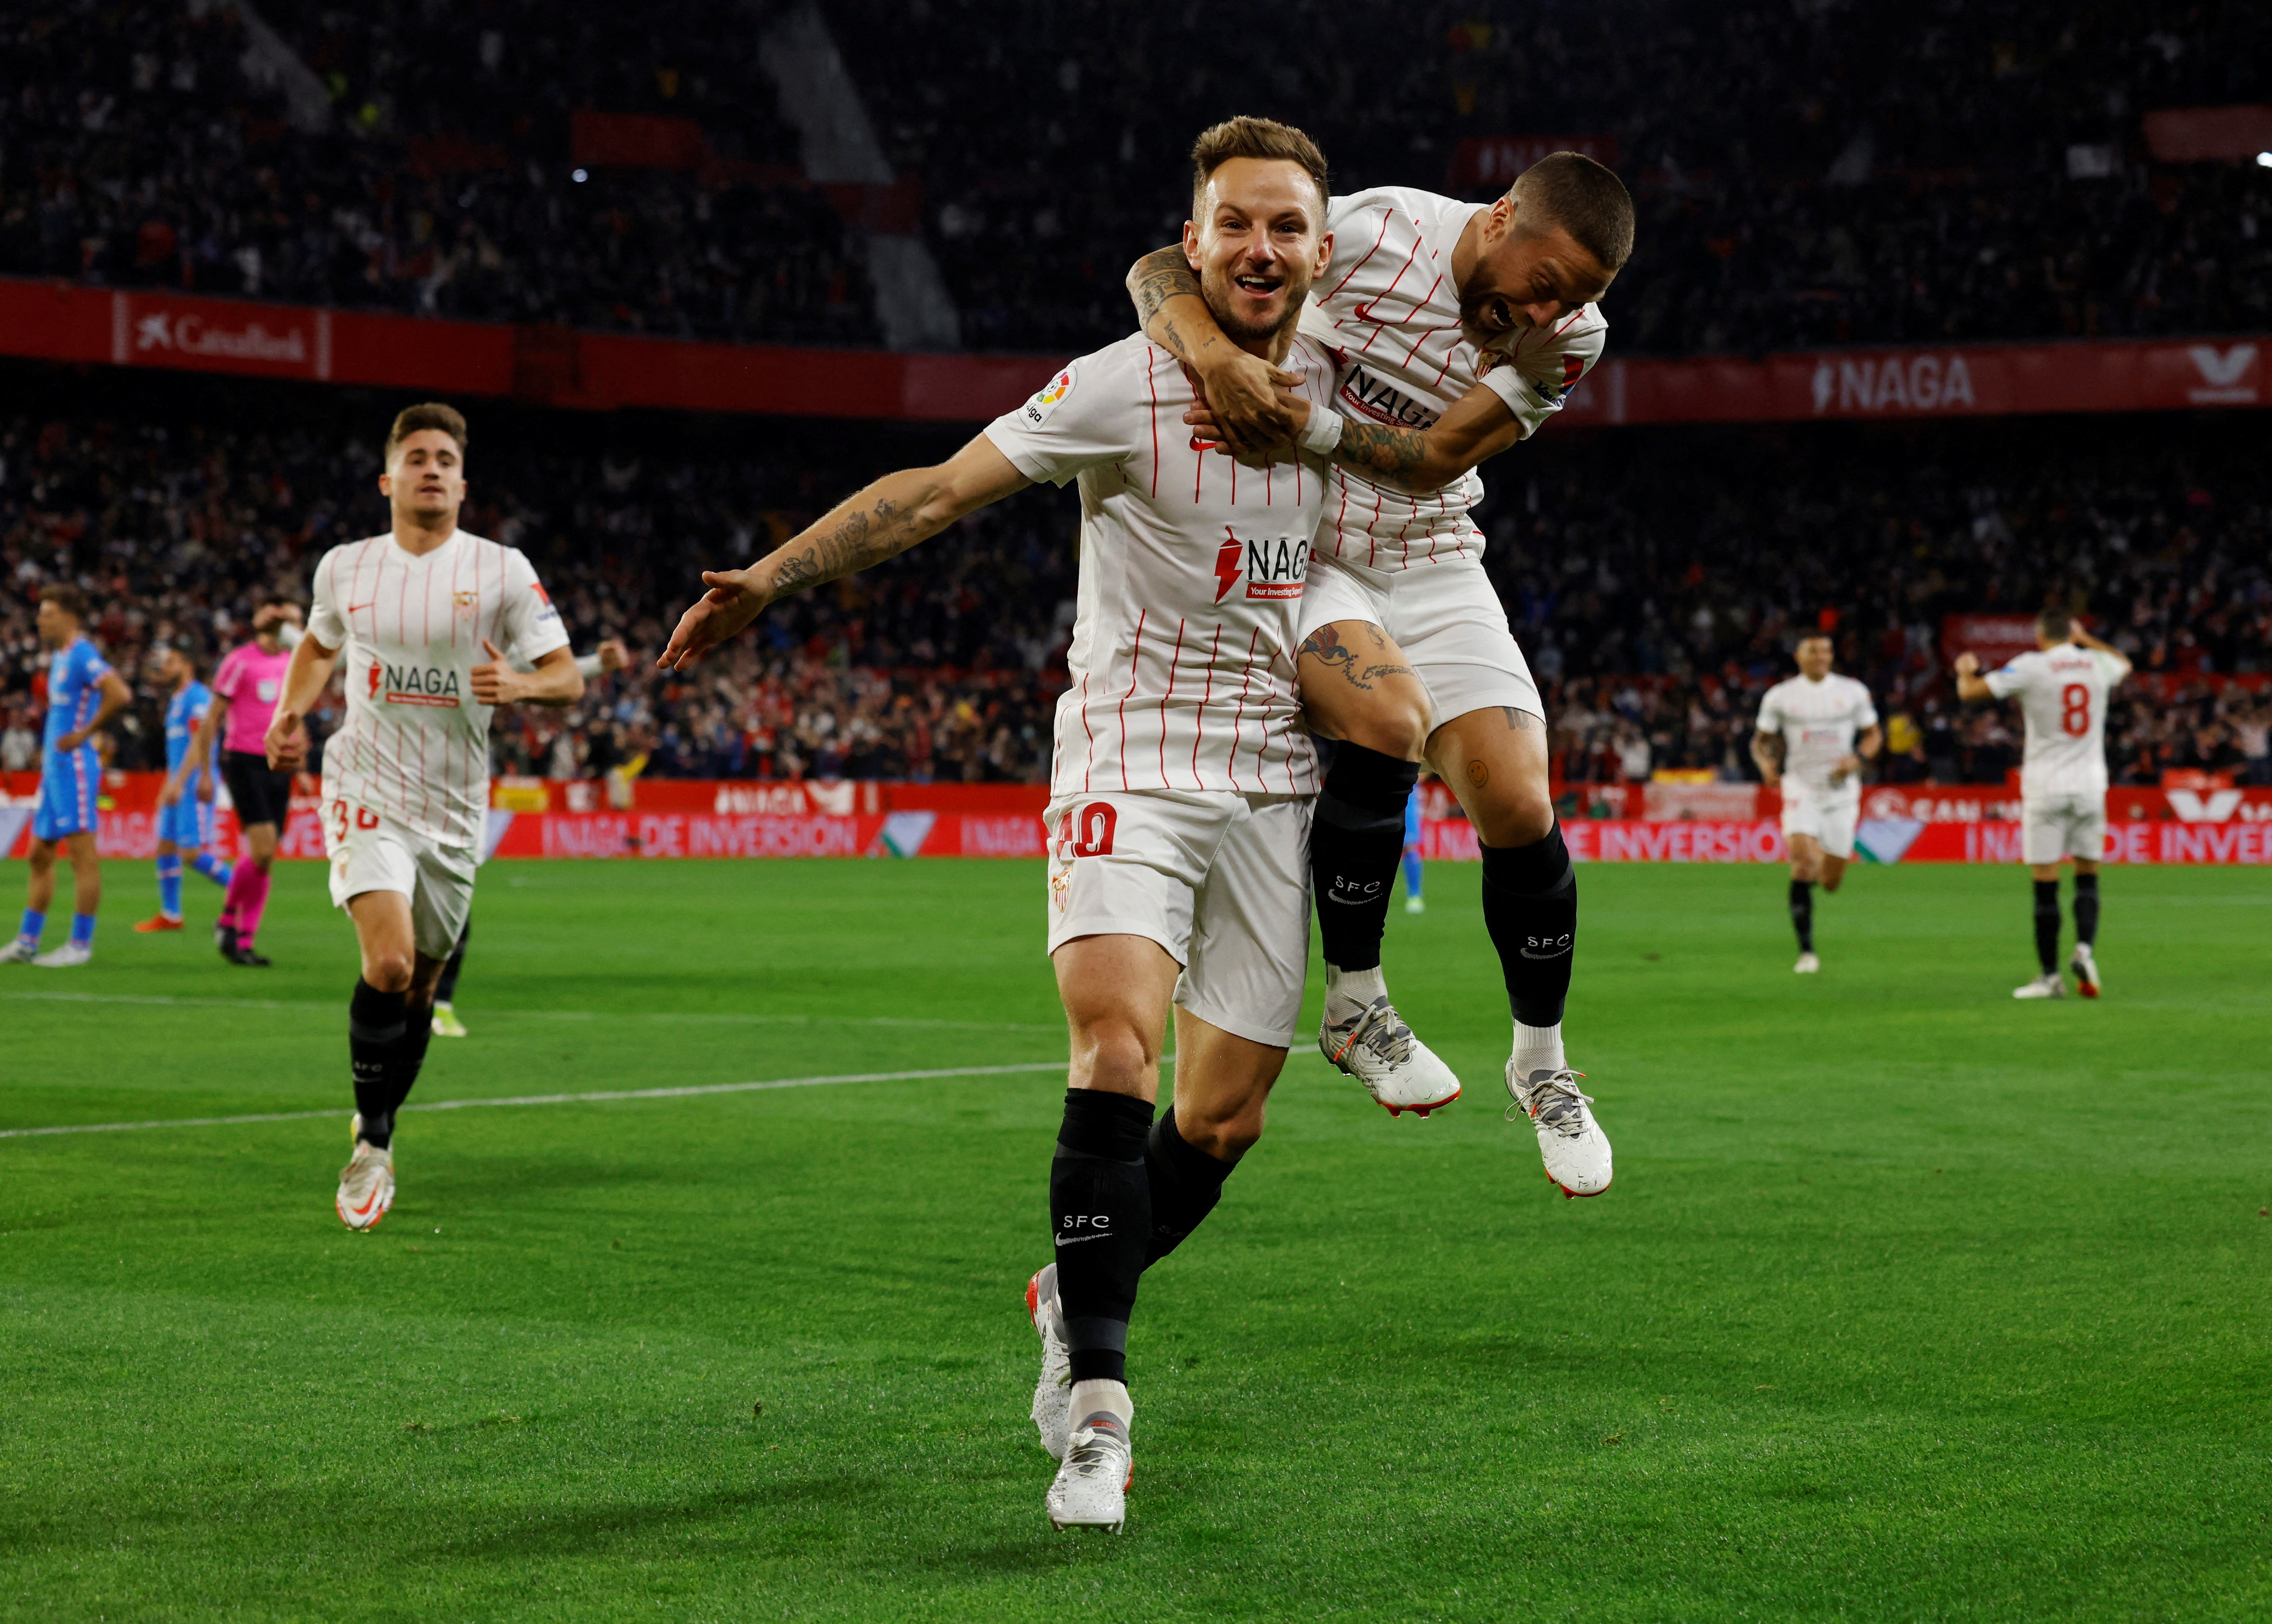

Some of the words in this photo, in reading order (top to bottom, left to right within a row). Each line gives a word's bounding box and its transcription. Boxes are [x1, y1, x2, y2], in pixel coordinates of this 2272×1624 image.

[1839, 354, 1976, 410] NAGA
[1345, 389, 1360, 406] Your
[1360, 402, 1396, 425] Investing
[1251, 587, 1267, 595] Your
[1268, 588, 1293, 597] Investing
[386, 665, 459, 695] NAGA
[2062, 684, 2090, 738] 8
[640, 815, 683, 857] DE
[1336, 876, 1380, 892] SFC
[1528, 934, 1569, 948] SFC
[1064, 1216, 1109, 1228] SFC
[1158, 1225, 1186, 1237] SF
